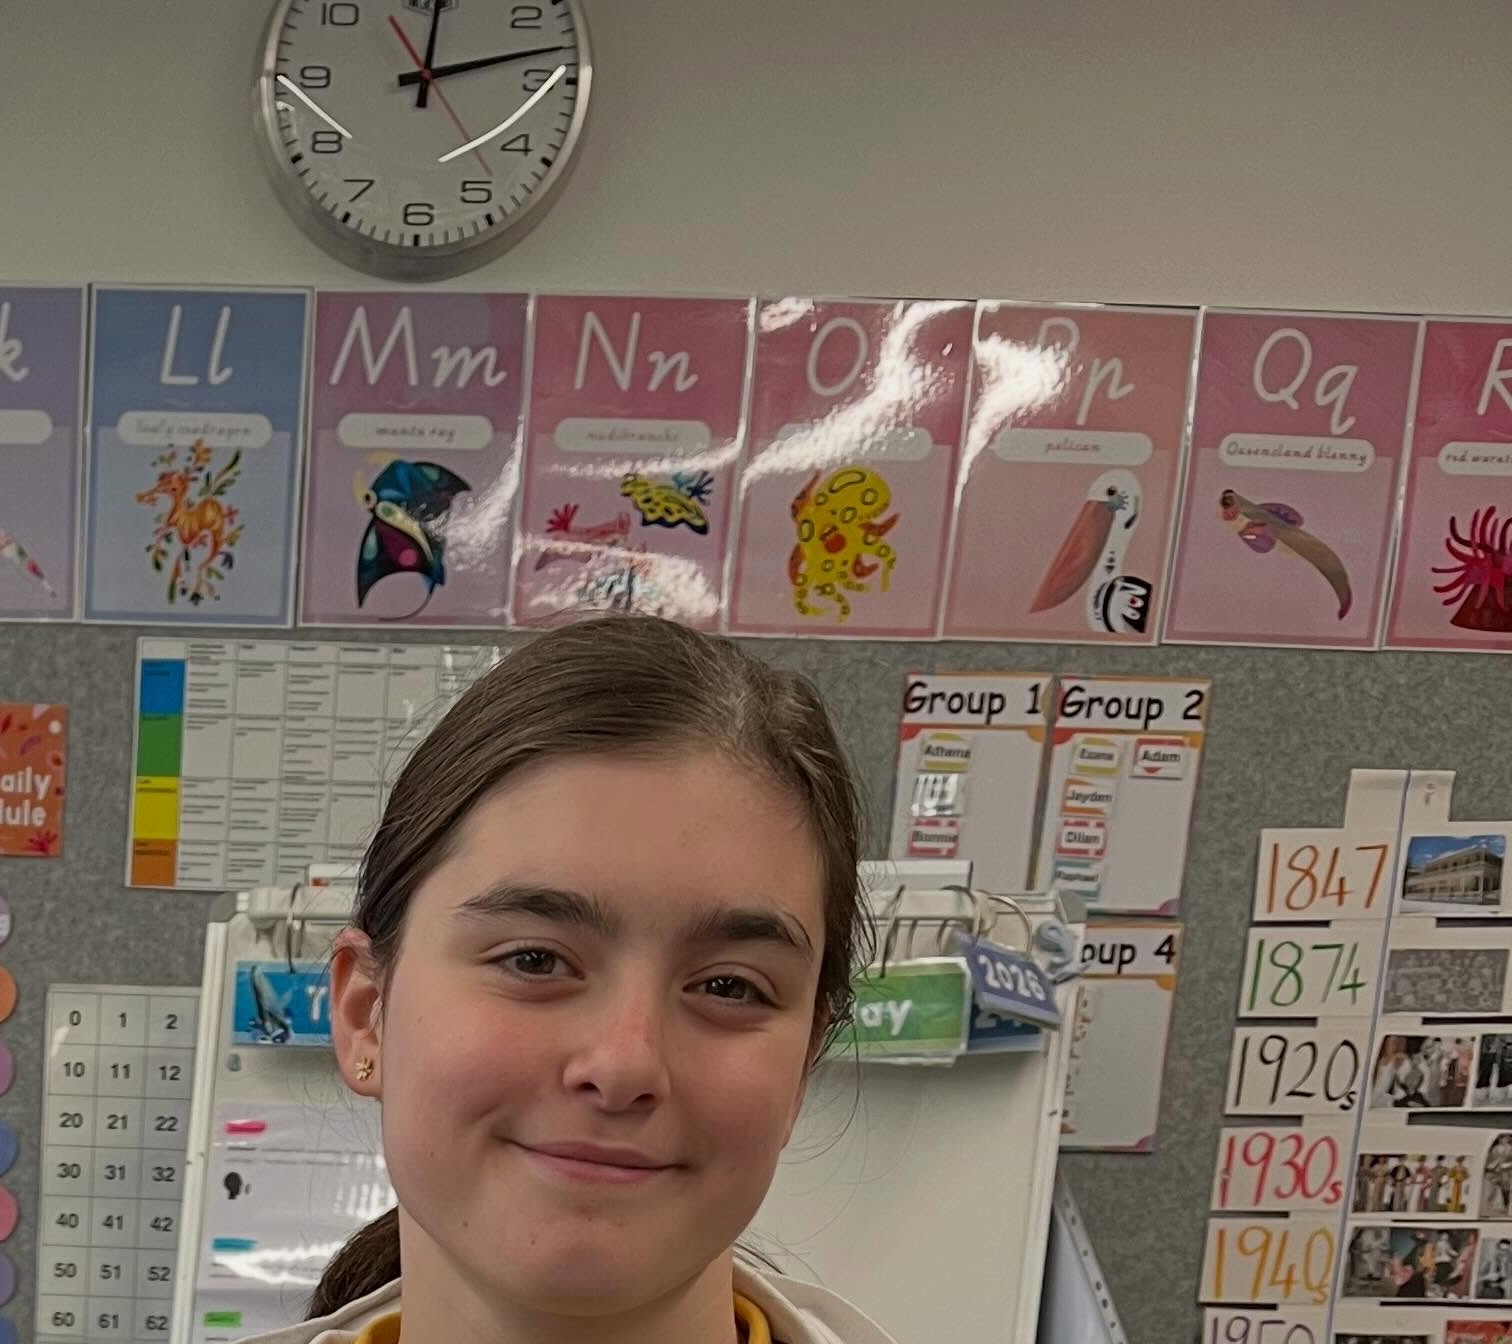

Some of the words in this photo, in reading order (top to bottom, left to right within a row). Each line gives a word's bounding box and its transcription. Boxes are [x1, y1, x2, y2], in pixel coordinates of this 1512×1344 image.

[321, 3, 358, 26] 10
[511, 6, 542, 28] 2
[300, 66, 330, 88] 9
[523, 69, 555, 92] 3
[312, 131, 342, 153] 8
[501, 134, 532, 156] 4
[344, 179, 375, 202] 7
[460, 181, 492, 203] 5
[403, 203, 434, 226] 6
[160, 304, 233, 386] Ll
[329, 305, 508, 390] Mm
[574, 311, 699, 393] Nn
[1253, 327, 1359, 436] Qq
[1226, 439, 1314, 459] Queensland
[1316, 445, 1370, 467] blenny
[903, 681, 1007, 725] Group
[1025, 683, 1041, 715] 1
[1060, 685, 1163, 730] Group
[1183, 689, 1205, 720] 2
[1265, 842, 1389, 915] 1847
[1081, 942, 1136, 974] oup
[1155, 934, 1177, 963] 4
[978, 954, 1047, 1002] 2026
[1247, 939, 1366, 1011] 1874
[69, 1010, 81, 1026] 0
[119, 1012, 128, 1028] 1
[166, 1014, 178, 1030] 2
[860, 1000, 913, 1036] ay
[63, 1061, 86, 1078] 10
[111, 1063, 131, 1079] 11
[159, 1065, 181, 1081] 12
[1234, 1034, 1360, 1111] 1920s
[59, 1112, 83, 1128] 20
[107, 1114, 128, 1130] 21
[57, 1163, 81, 1179] 30
[1217, 1131, 1343, 1208] 1930s
[55, 1213, 79, 1229] 40
[53, 1263, 77, 1278] 50
[1215, 1224, 1336, 1305] 1940s
[52, 1312, 75, 1328] 60
